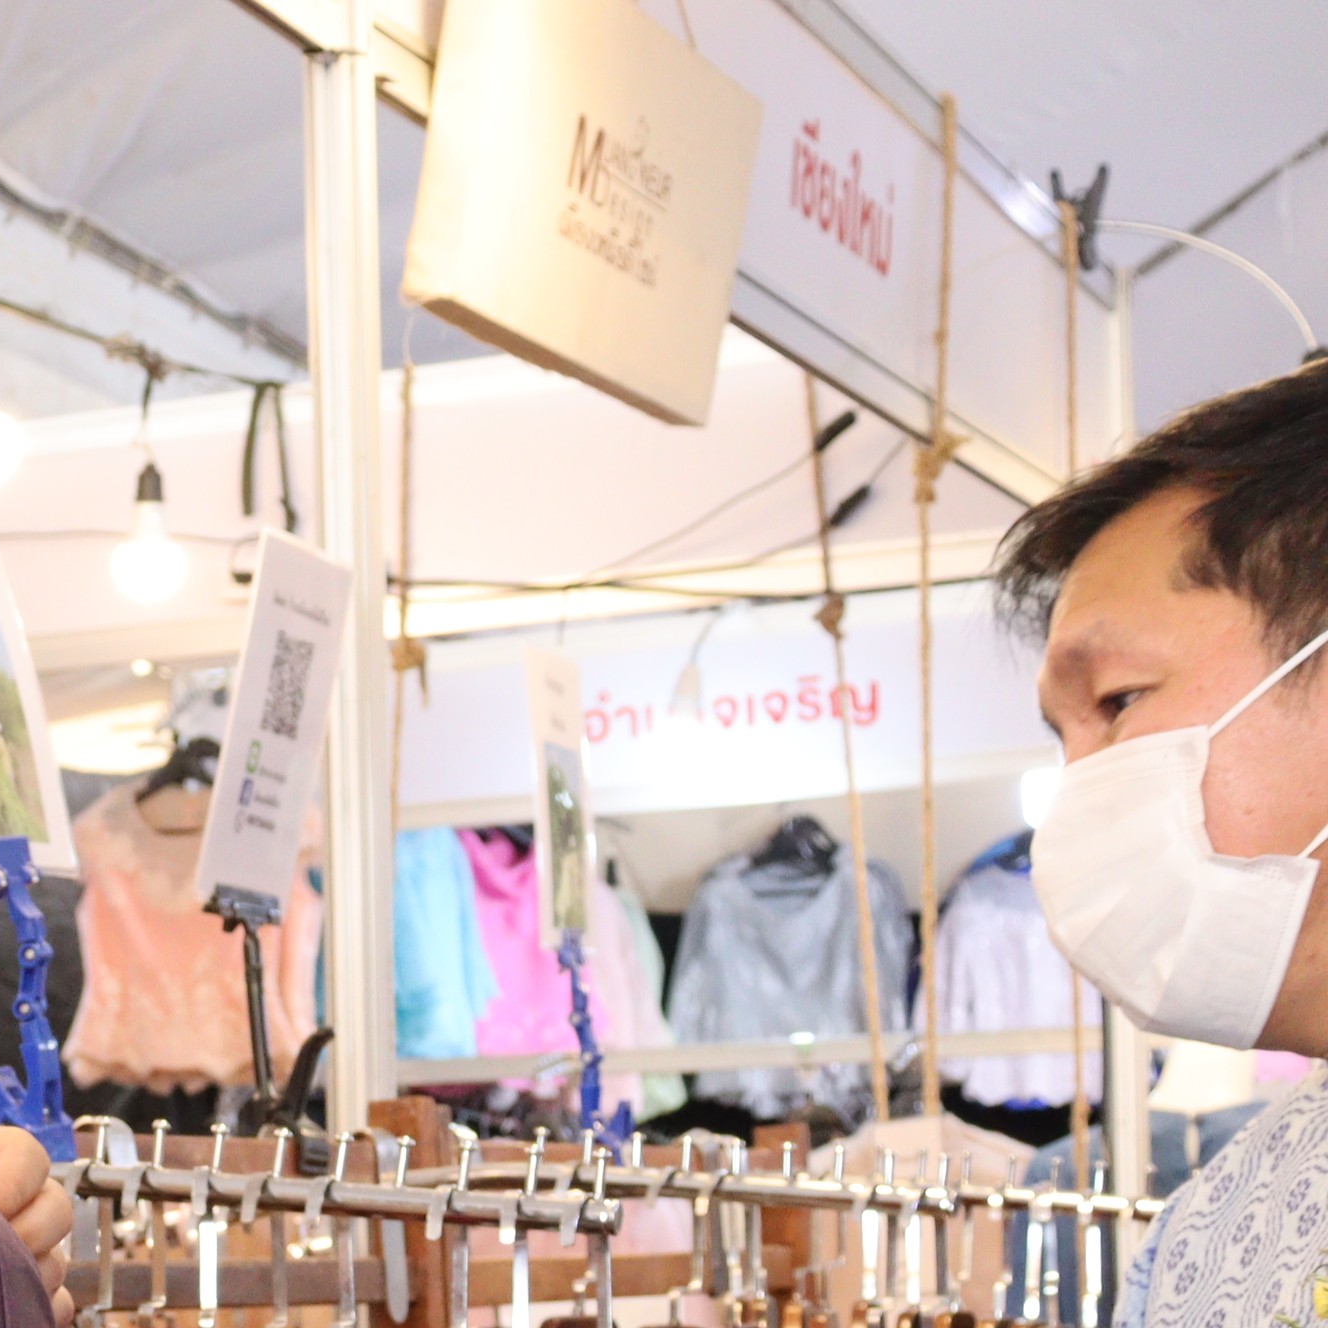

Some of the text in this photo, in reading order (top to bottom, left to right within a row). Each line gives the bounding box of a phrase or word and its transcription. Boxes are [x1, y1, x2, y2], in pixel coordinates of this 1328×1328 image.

[790, 119, 895, 278] เชียงใหม่
[583, 676, 880, 743] อำจเจริญ
